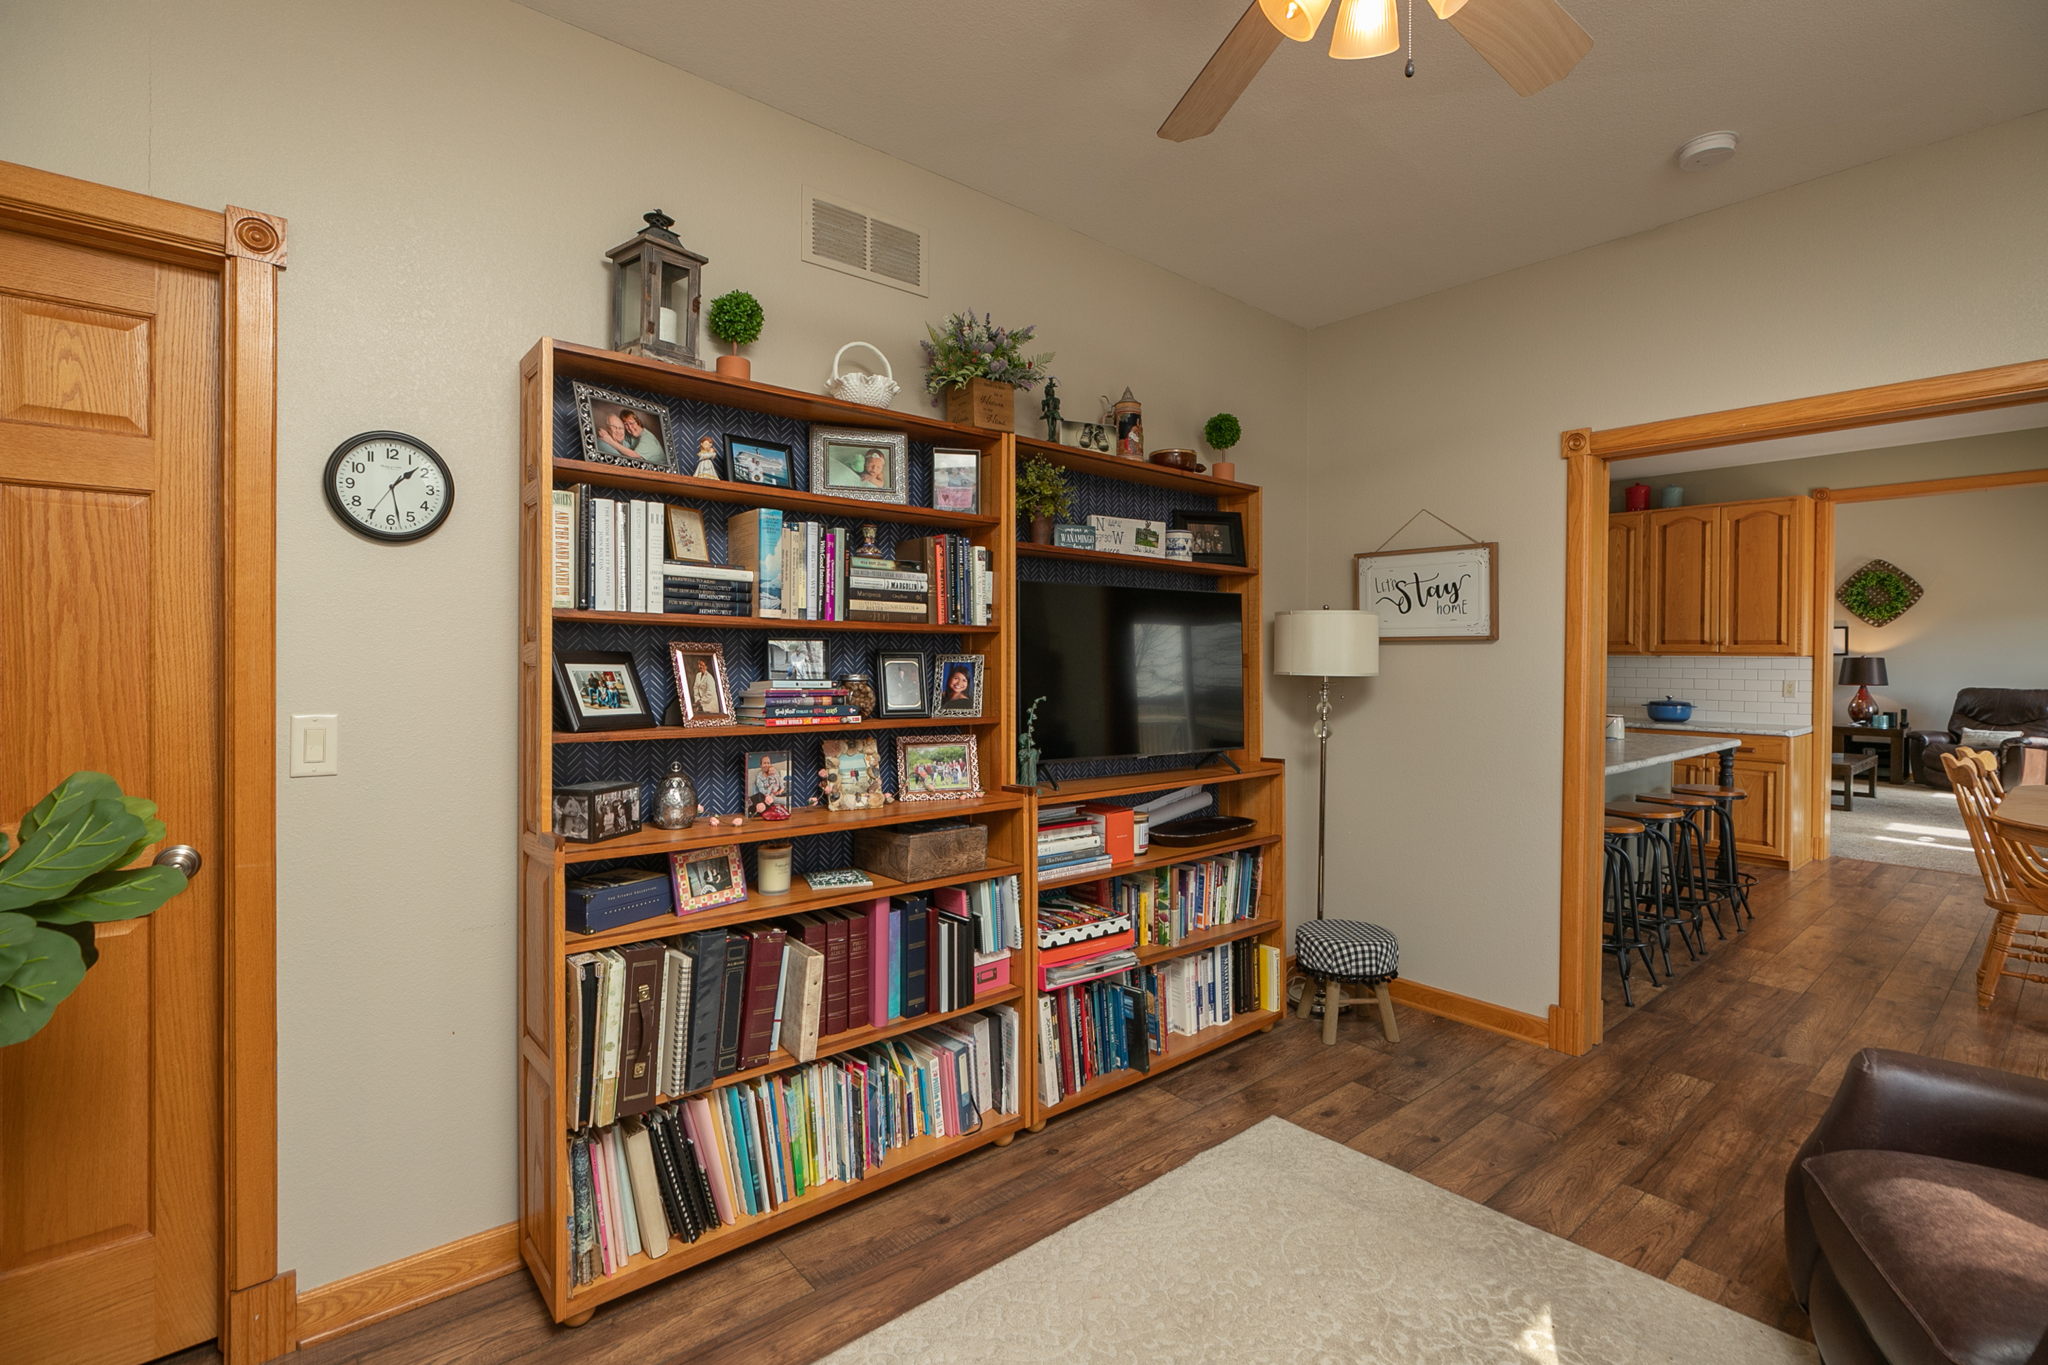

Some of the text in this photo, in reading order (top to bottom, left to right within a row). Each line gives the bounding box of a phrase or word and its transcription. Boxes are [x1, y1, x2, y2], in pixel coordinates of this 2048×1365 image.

[367, 450, 374, 462] 11
[386, 448, 399, 460] 12
[352, 462, 365, 474] 10
[420, 468, 429, 478] 2
[345, 477, 355, 488] 9
[426, 485, 435, 496] 3
[351, 495, 362, 506] 8
[420, 500, 429, 511] 4
[366, 508, 376, 520] 7
[386, 514, 396, 525] 6
[406, 511, 415, 522] 5
[1096, 516, 1105, 531] N
[1112, 531, 1124, 544] W
[555, 510, 570, 596] AND THE BAND PLAYED ON
[1376, 572, 1471, 614] Stay
